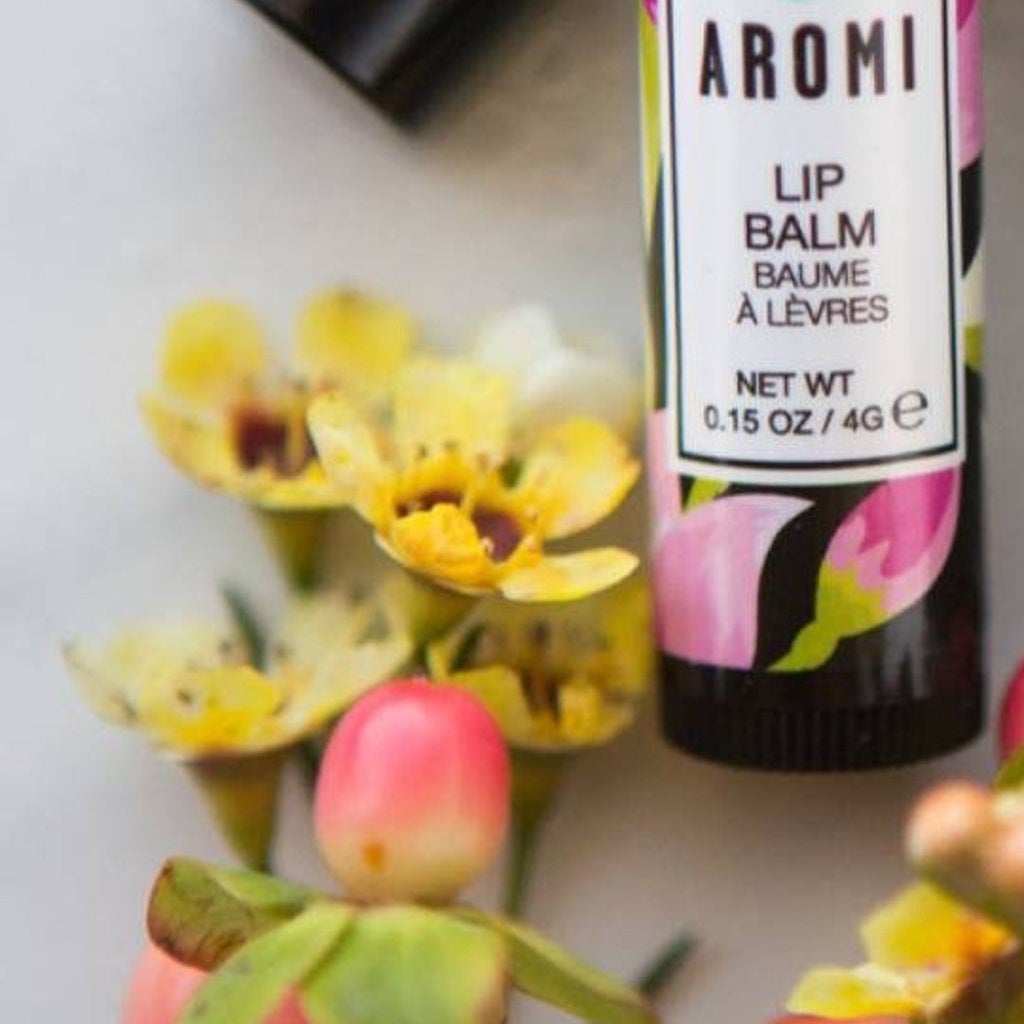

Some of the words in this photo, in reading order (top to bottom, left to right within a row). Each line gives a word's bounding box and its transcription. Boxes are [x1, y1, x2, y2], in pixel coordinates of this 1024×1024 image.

[700, 15, 915, 100] AROMI
[775, 163, 844, 202] LIP
[745, 210, 875, 250] BALM
[755, 260, 870, 289] BAUME
[736, 293, 757, 325] À
[768, 293, 889, 326] LÈVRES
[737, 371, 795, 397] NET
[804, 370, 854, 395] WT
[704, 406, 759, 434] 0.15
[769, 408, 813, 435] OZ
[821, 410, 833, 434] /
[843, 406, 883, 433] 4G
